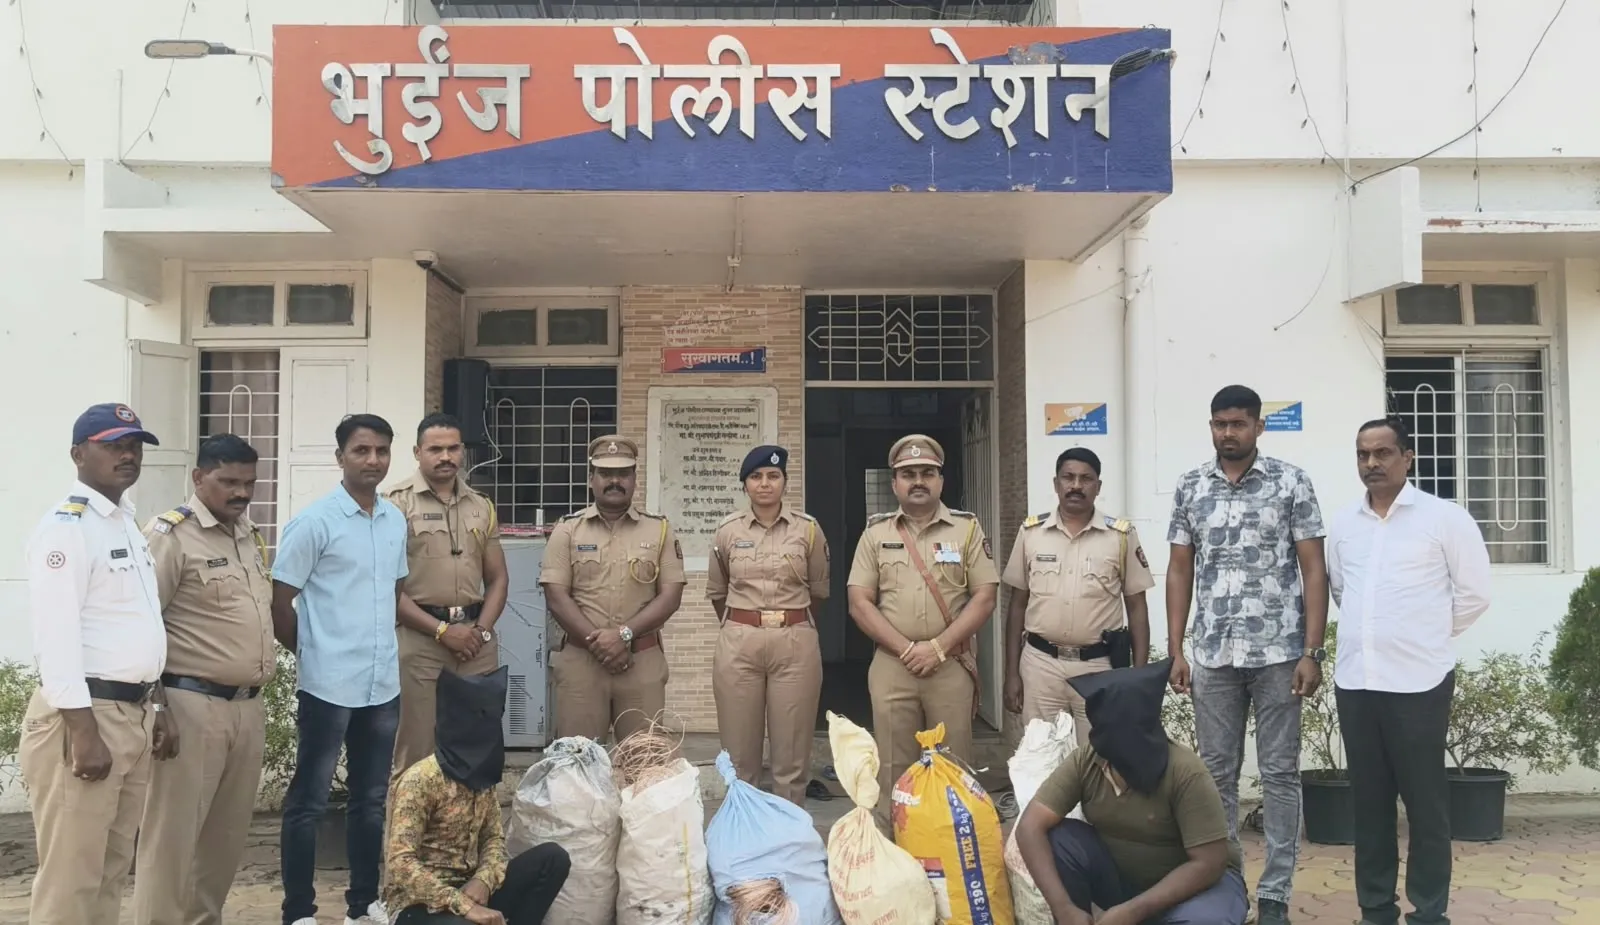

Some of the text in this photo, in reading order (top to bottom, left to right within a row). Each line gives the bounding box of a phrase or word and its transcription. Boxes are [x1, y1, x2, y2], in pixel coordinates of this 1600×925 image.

[321, 25, 1112, 175] भुईंज पोलीस स्टेशन
[959, 825, 971, 834] 2
[961, 812, 970, 824] kg
[960, 836, 977, 870] FREE
